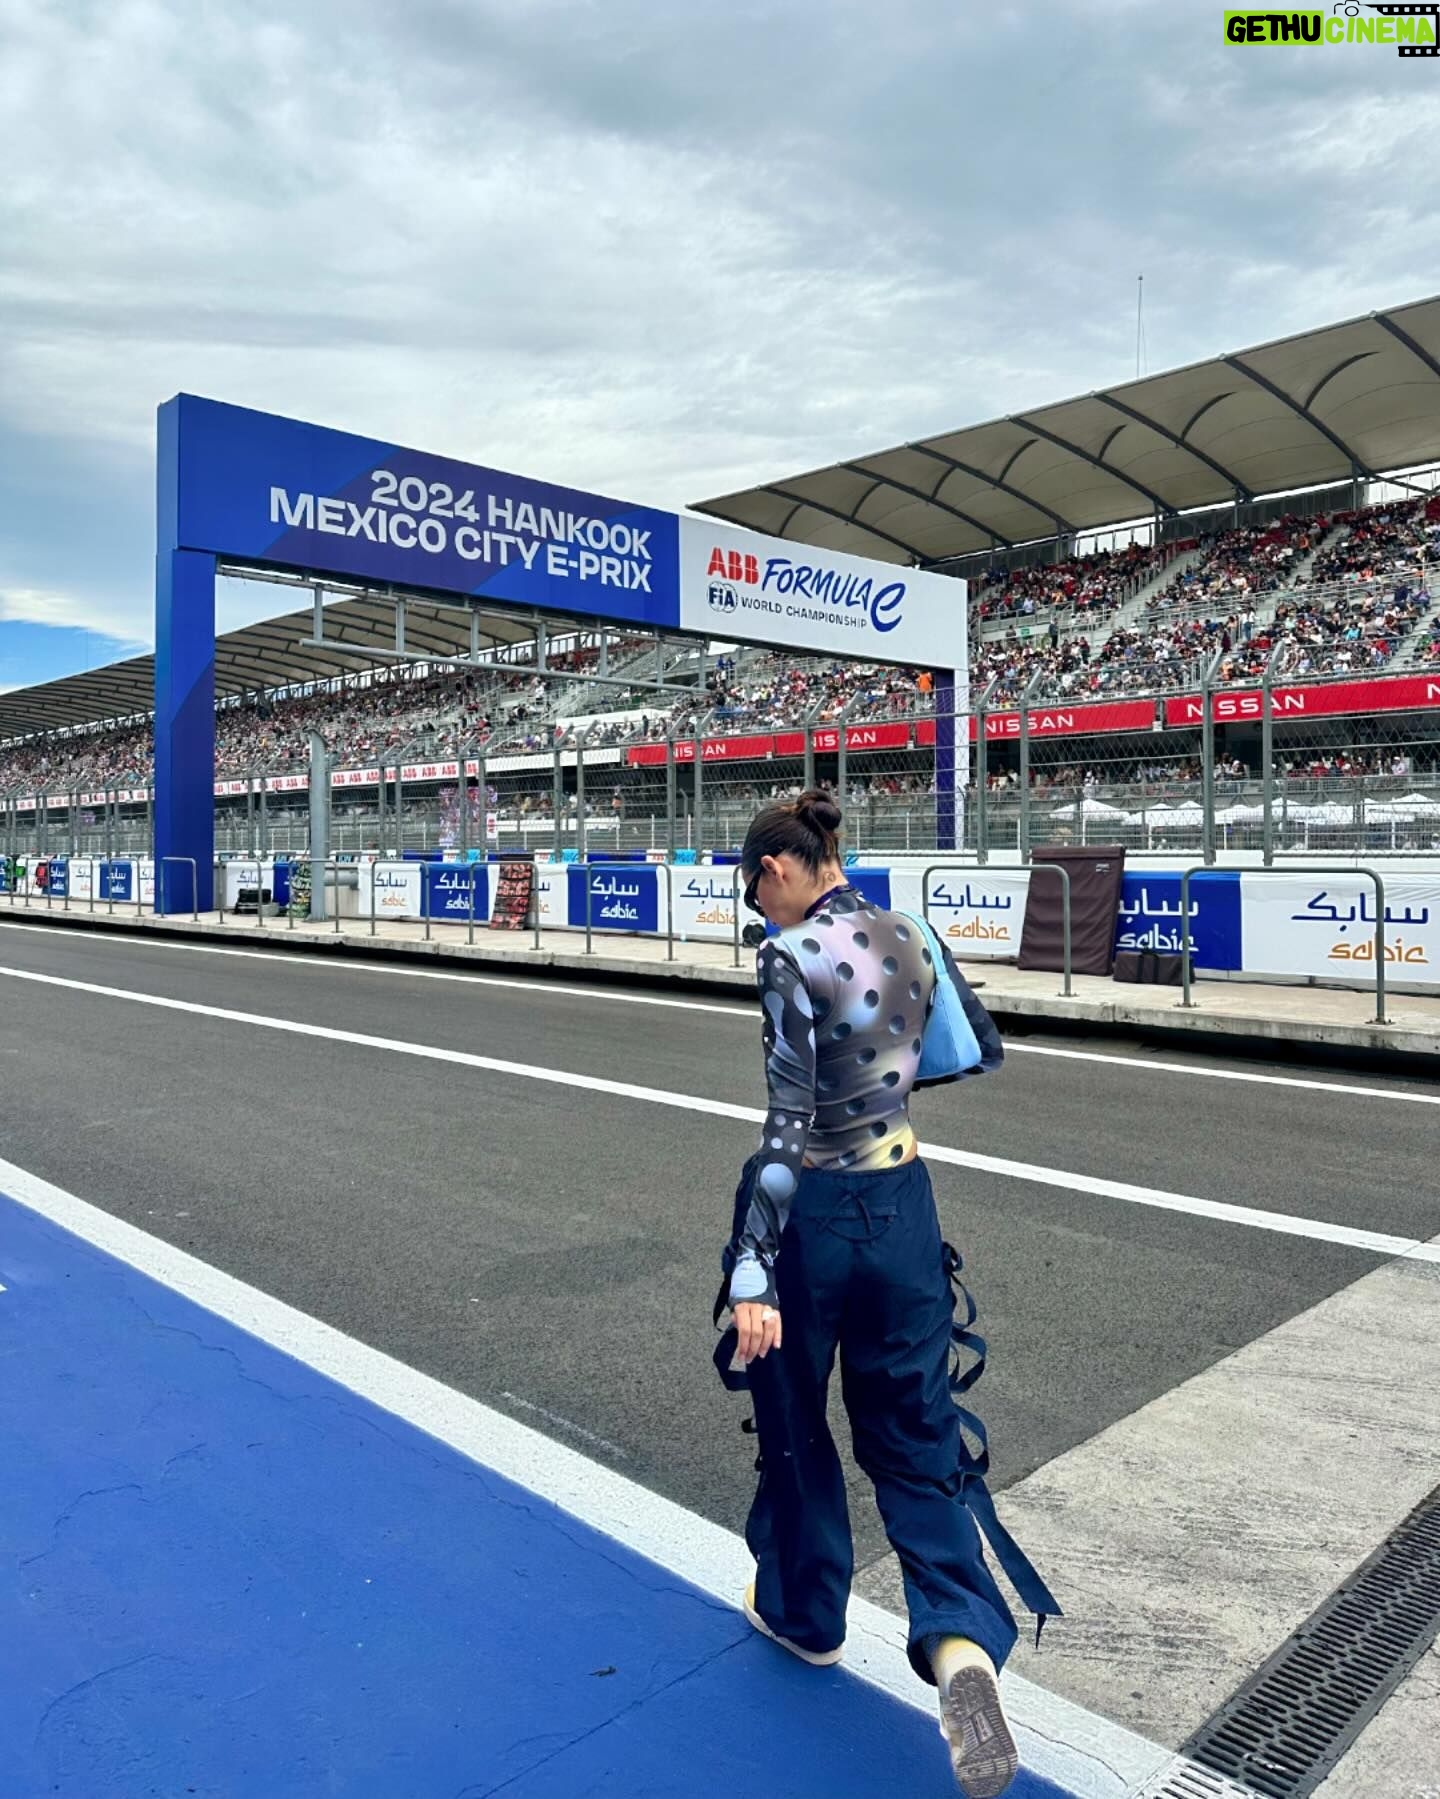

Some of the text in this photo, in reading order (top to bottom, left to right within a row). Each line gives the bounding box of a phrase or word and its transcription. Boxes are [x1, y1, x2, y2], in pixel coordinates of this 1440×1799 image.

[371, 470, 652, 560] 2024 HANKOOK
[270, 486, 652, 593] MEXICO CITY E-PRIX
[707, 547, 759, 585] ABB
[761, 558, 873, 612] FORMULA
[741, 596, 782, 614] WORLD
[786, 605, 867, 628] CHAMPIONSHIP
[403, 768, 417, 778] ABB
[422, 766, 436, 777] ABB
[442, 765, 456, 775] ABB
[590, 876, 640, 900] سابك
[928, 884, 1011, 916] سابك
[600, 900, 639, 919] sabic
[1291, 892, 1428, 932] سابك
[946, 915, 1011, 941] sabic
[1116, 923, 1199, 952] sabic
[1327, 932, 1429, 963] sabic
